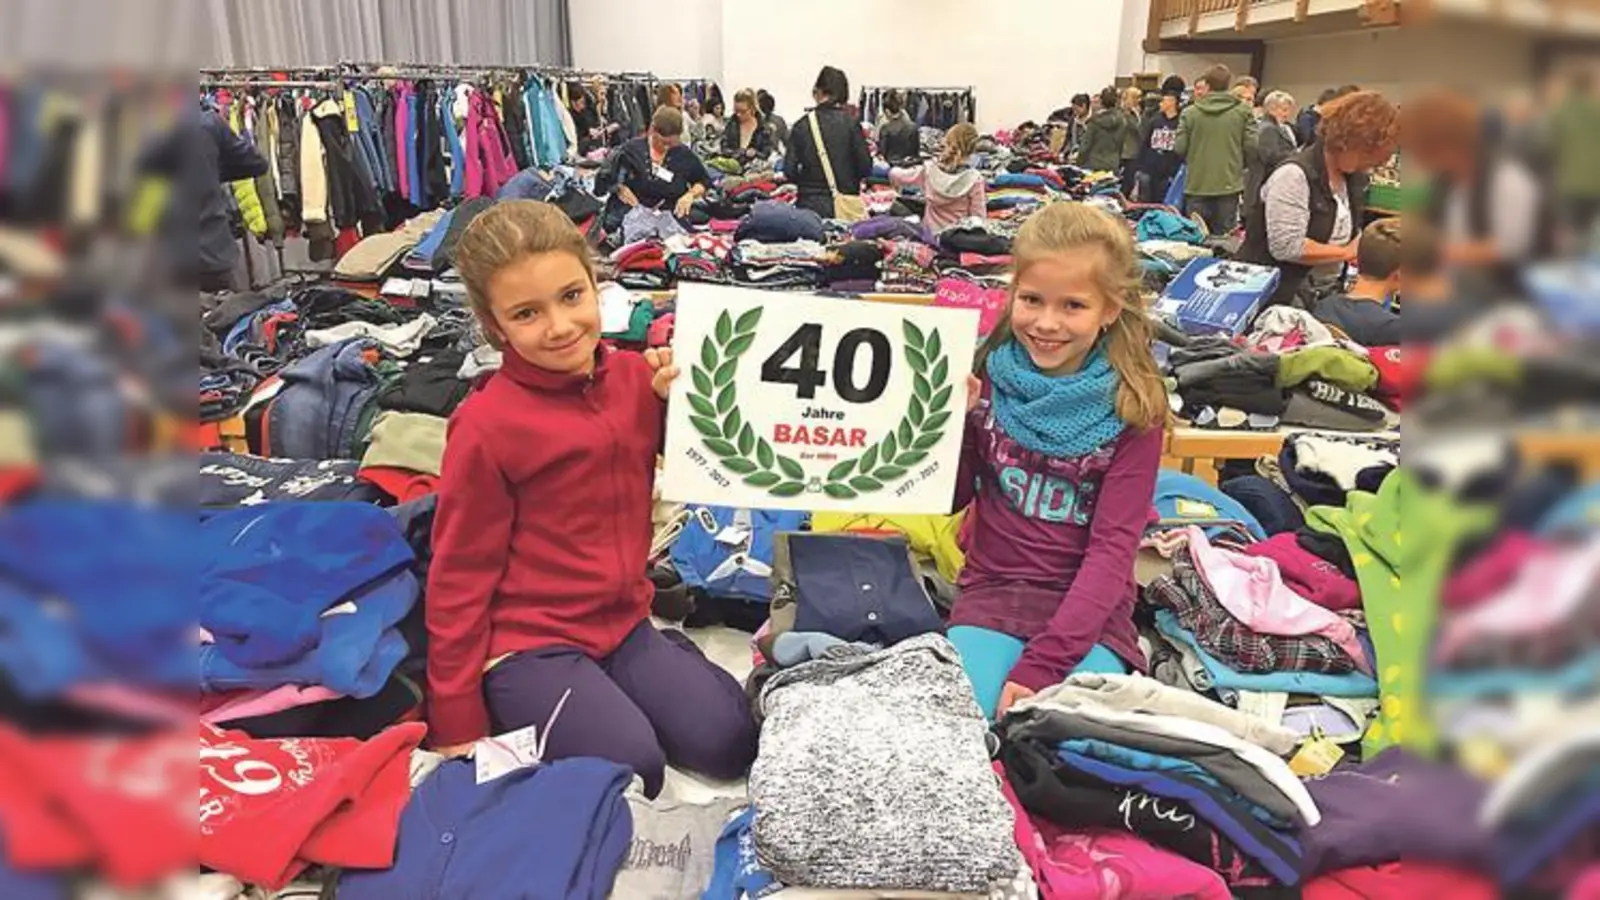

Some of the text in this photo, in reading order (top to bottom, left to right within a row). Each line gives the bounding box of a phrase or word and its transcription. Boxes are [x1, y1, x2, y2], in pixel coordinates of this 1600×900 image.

[760, 322, 893, 405] 40
[801, 406, 846, 421] Jahre
[773, 423, 868, 448] BASAR
[709, 468, 731, 488] 2017
